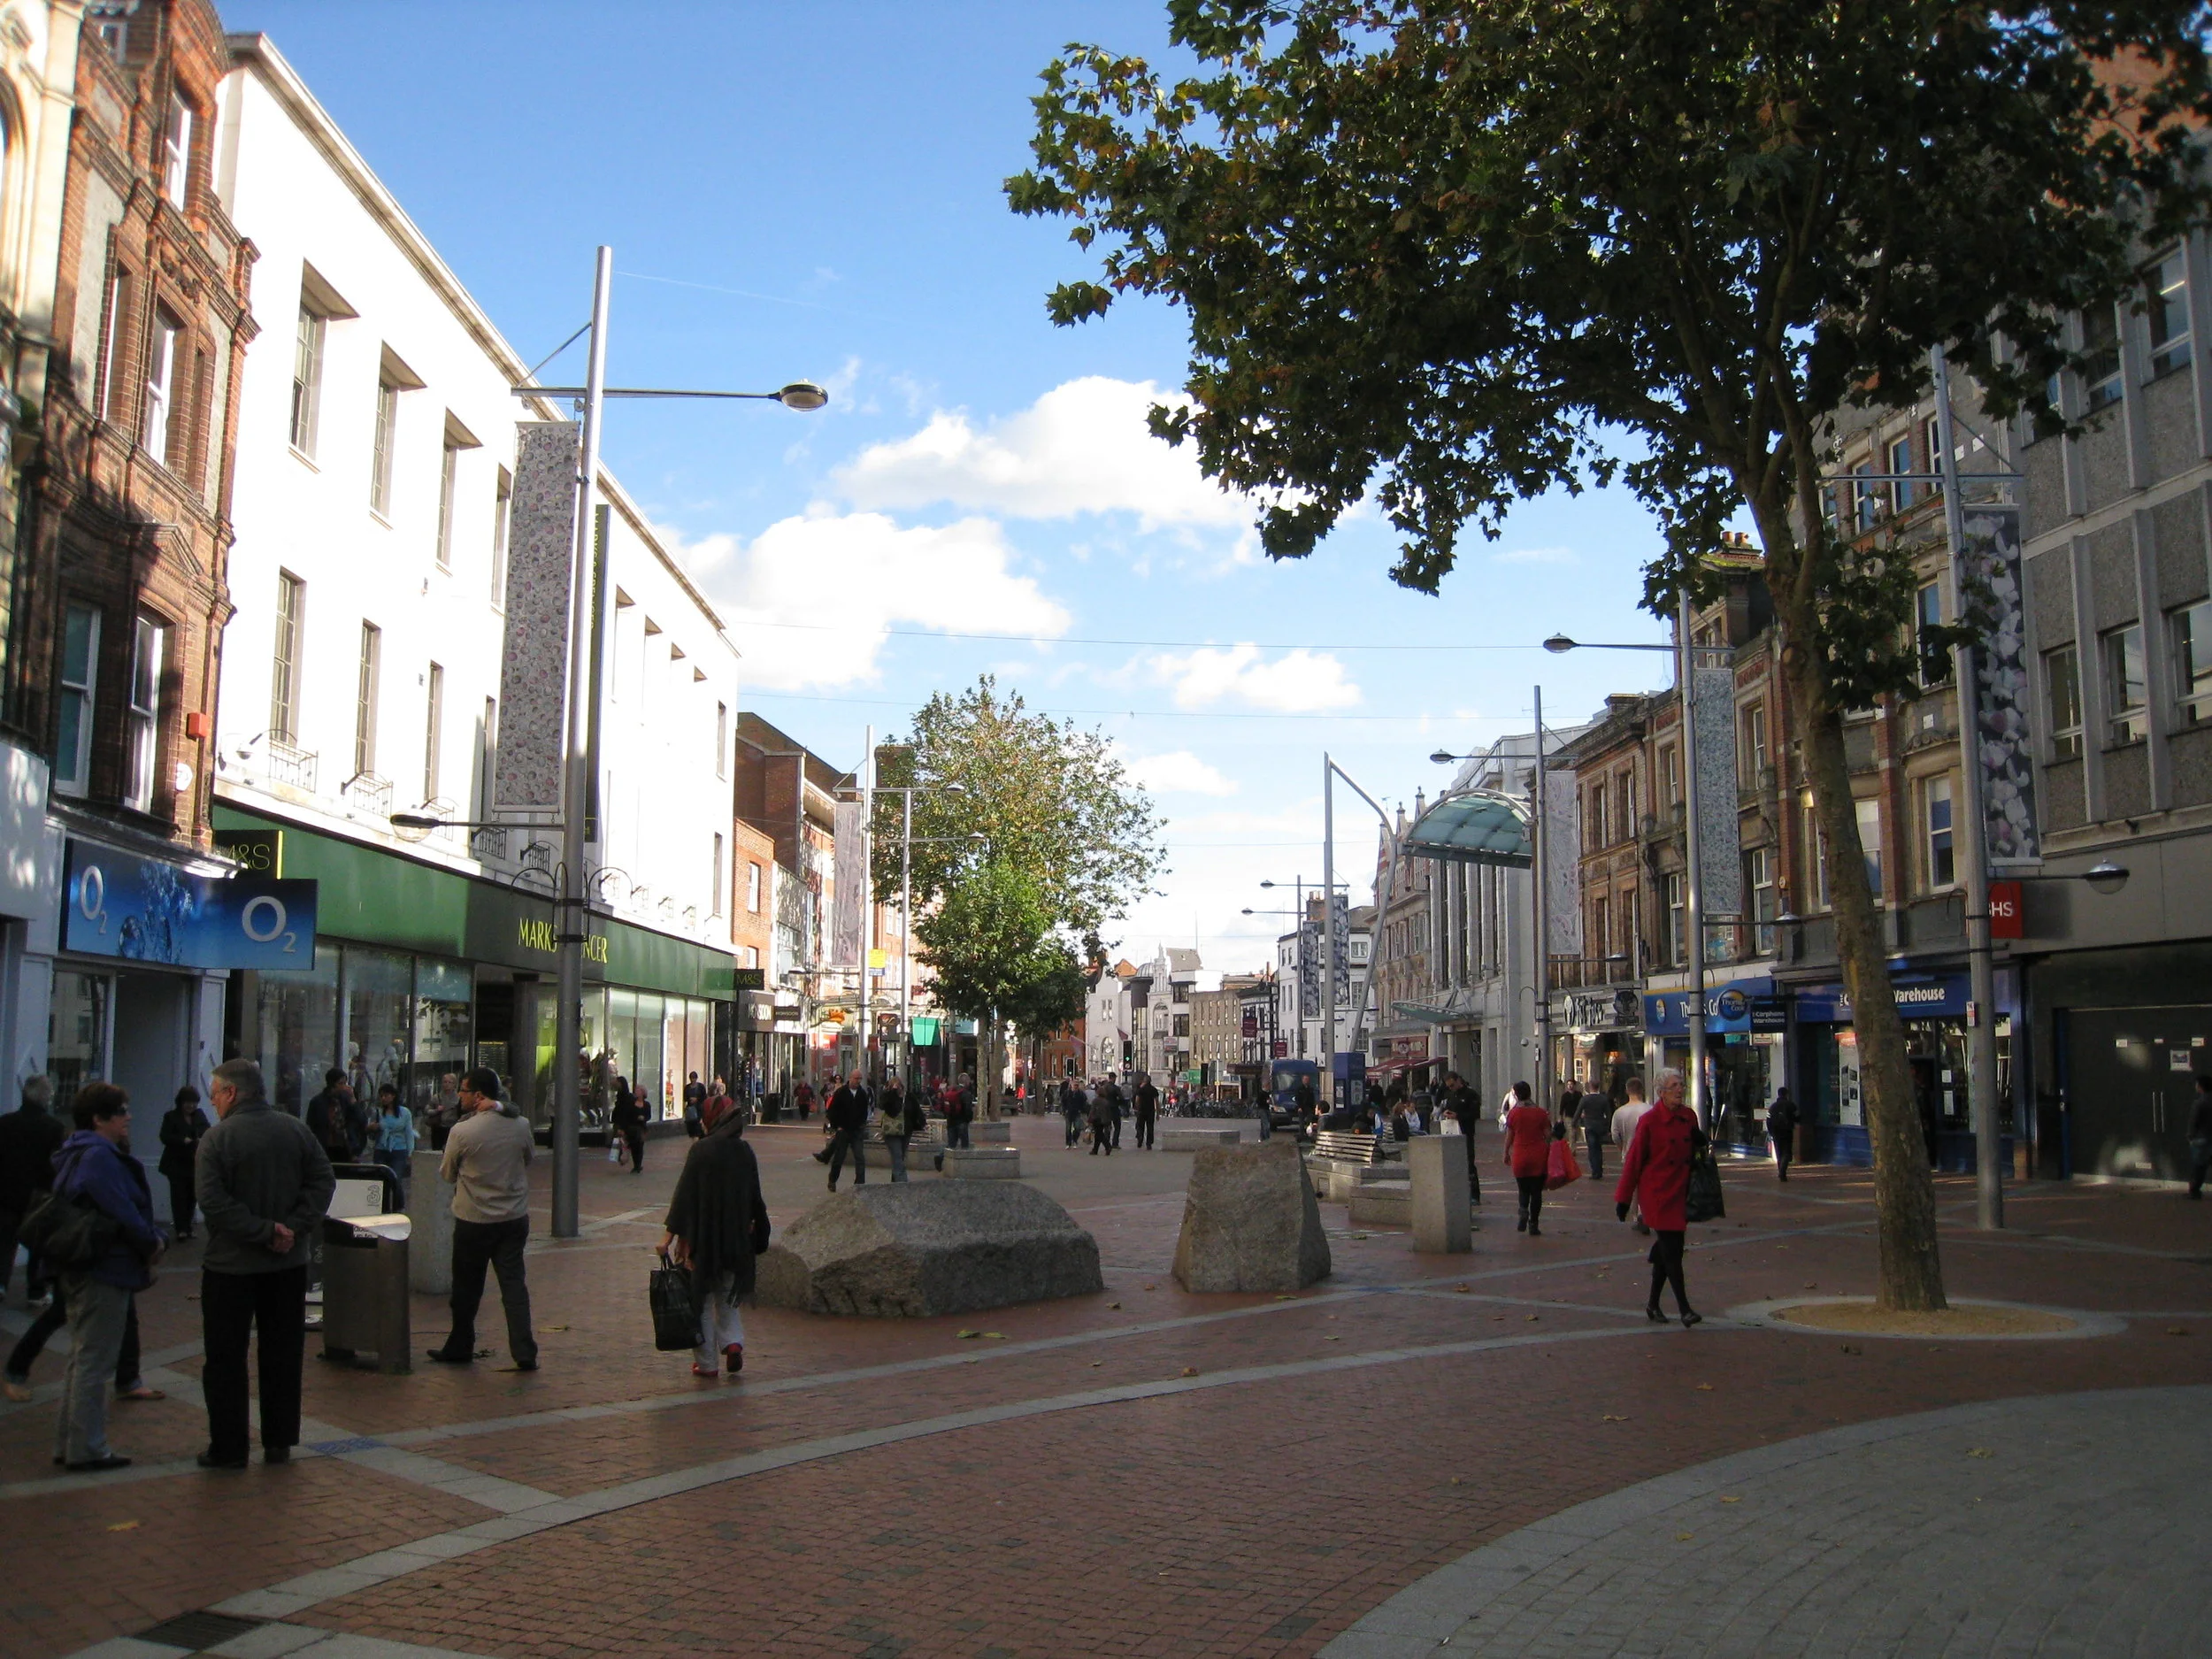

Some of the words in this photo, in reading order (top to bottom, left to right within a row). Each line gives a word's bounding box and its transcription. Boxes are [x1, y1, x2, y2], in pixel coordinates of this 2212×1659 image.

[242, 895, 296, 953] O2
[583, 934, 608, 964] NCER
[736, 973, 761, 985] M&S
[1709, 999, 1717, 1017] Co
